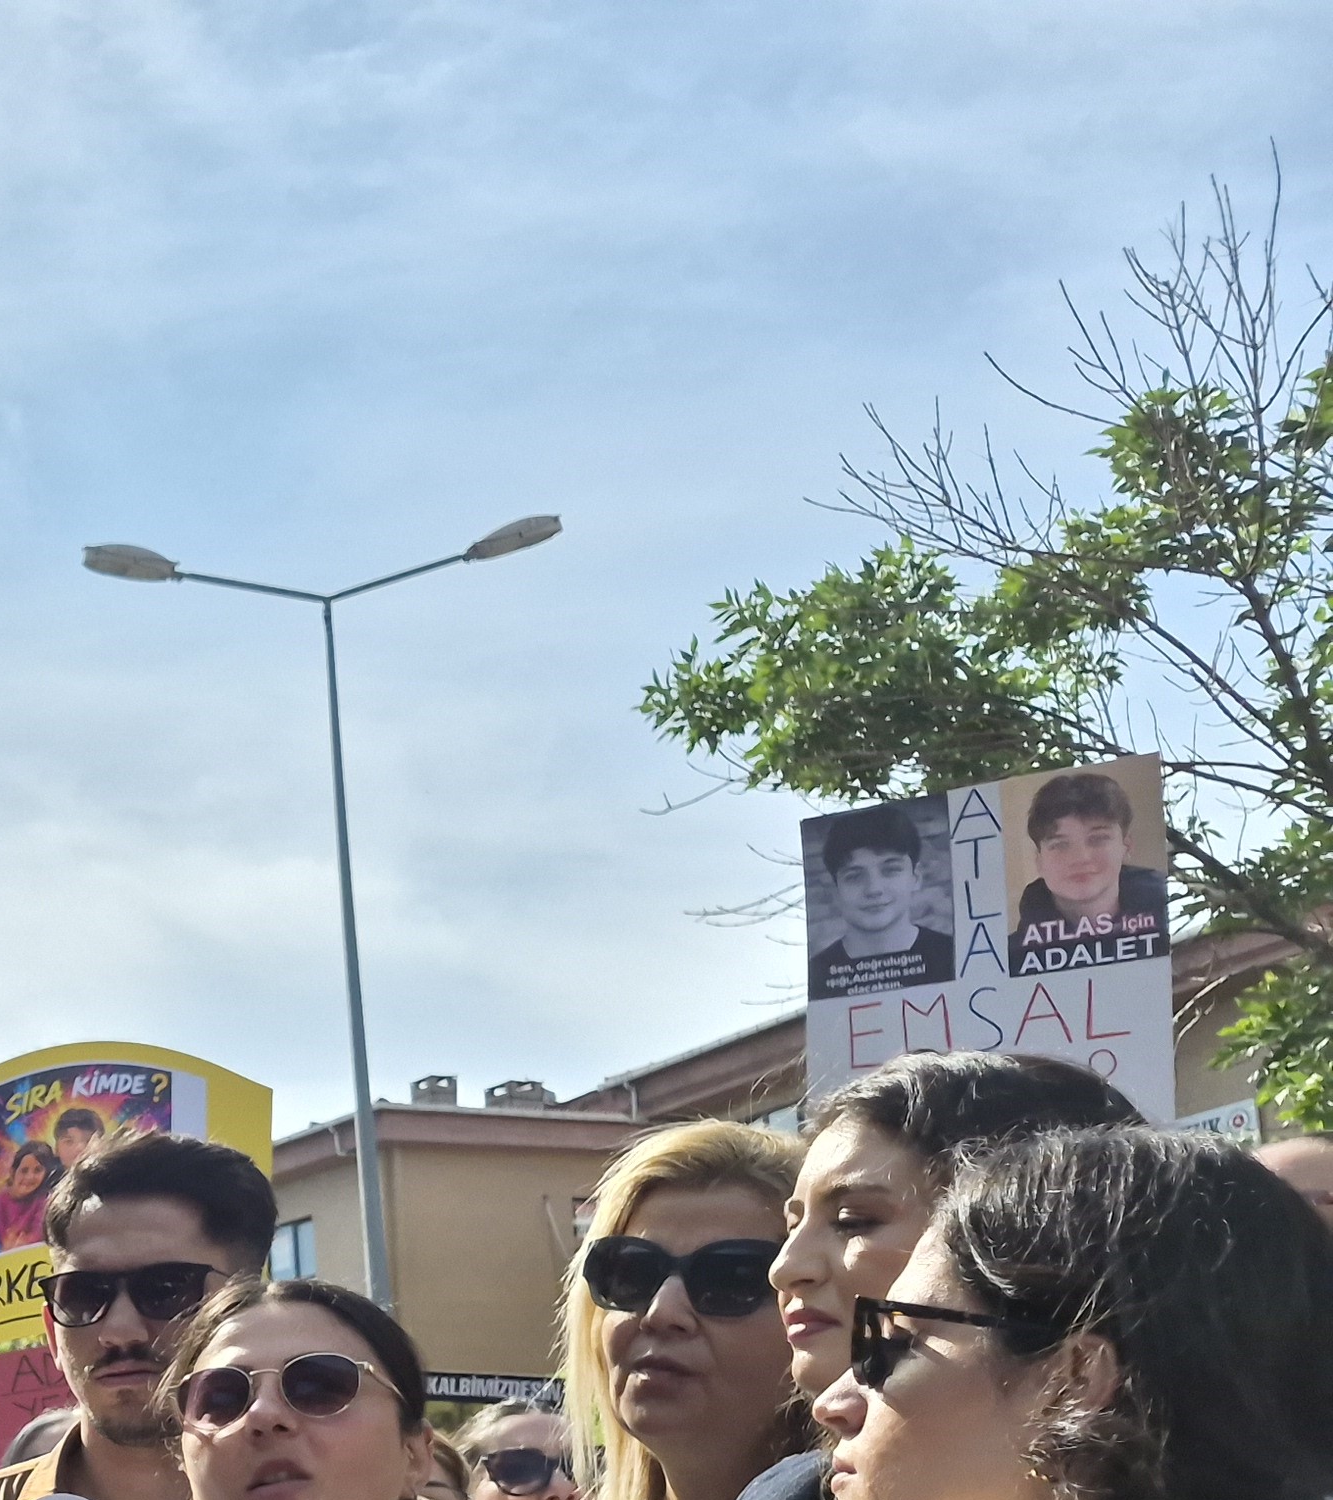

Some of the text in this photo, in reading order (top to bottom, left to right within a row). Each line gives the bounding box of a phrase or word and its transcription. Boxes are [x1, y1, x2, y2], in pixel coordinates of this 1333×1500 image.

[1022, 911, 1114, 946] ATLAS
[1019, 932, 1161, 975] ADALET
[848, 978, 1132, 1070] EMSAL
[4, 1069, 170, 1125] SIRA KİMDE ?
